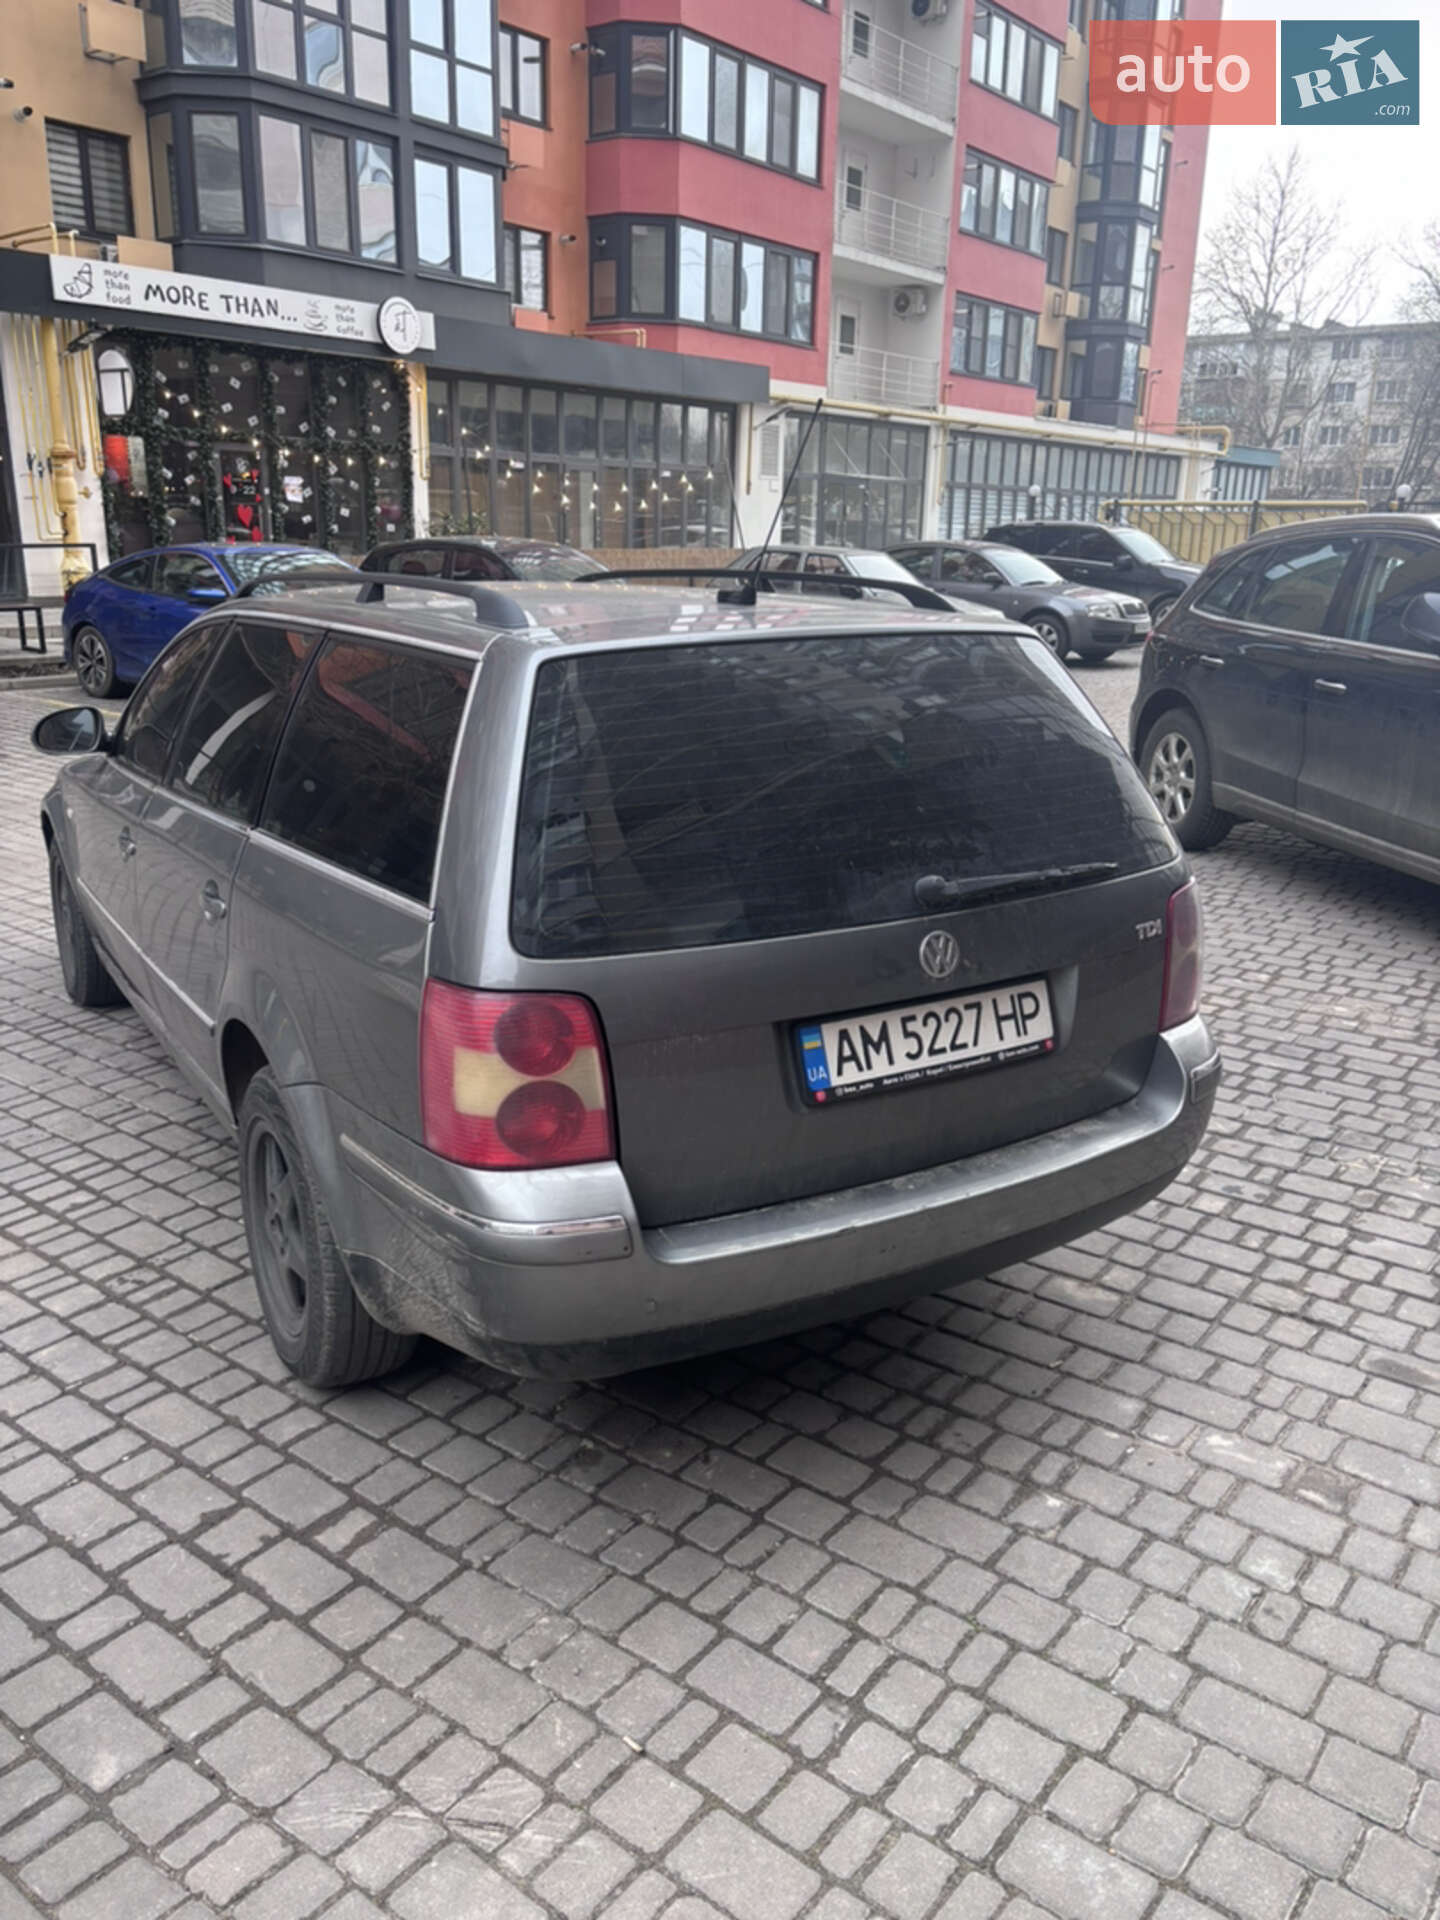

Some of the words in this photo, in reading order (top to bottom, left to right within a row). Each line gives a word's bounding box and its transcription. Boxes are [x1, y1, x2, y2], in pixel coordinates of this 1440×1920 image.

[103, 267, 129, 281] more
[105, 278, 131, 291] than
[106, 291, 132, 306] food
[144, 284, 210, 311] MORE
[1136, 918, 1162, 940] TDI
[836, 1020, 895, 1077] AM
[900, 1001, 983, 1060] 5227
[992, 991, 1040, 1042] HP
[807, 1064, 828, 1083] UA
